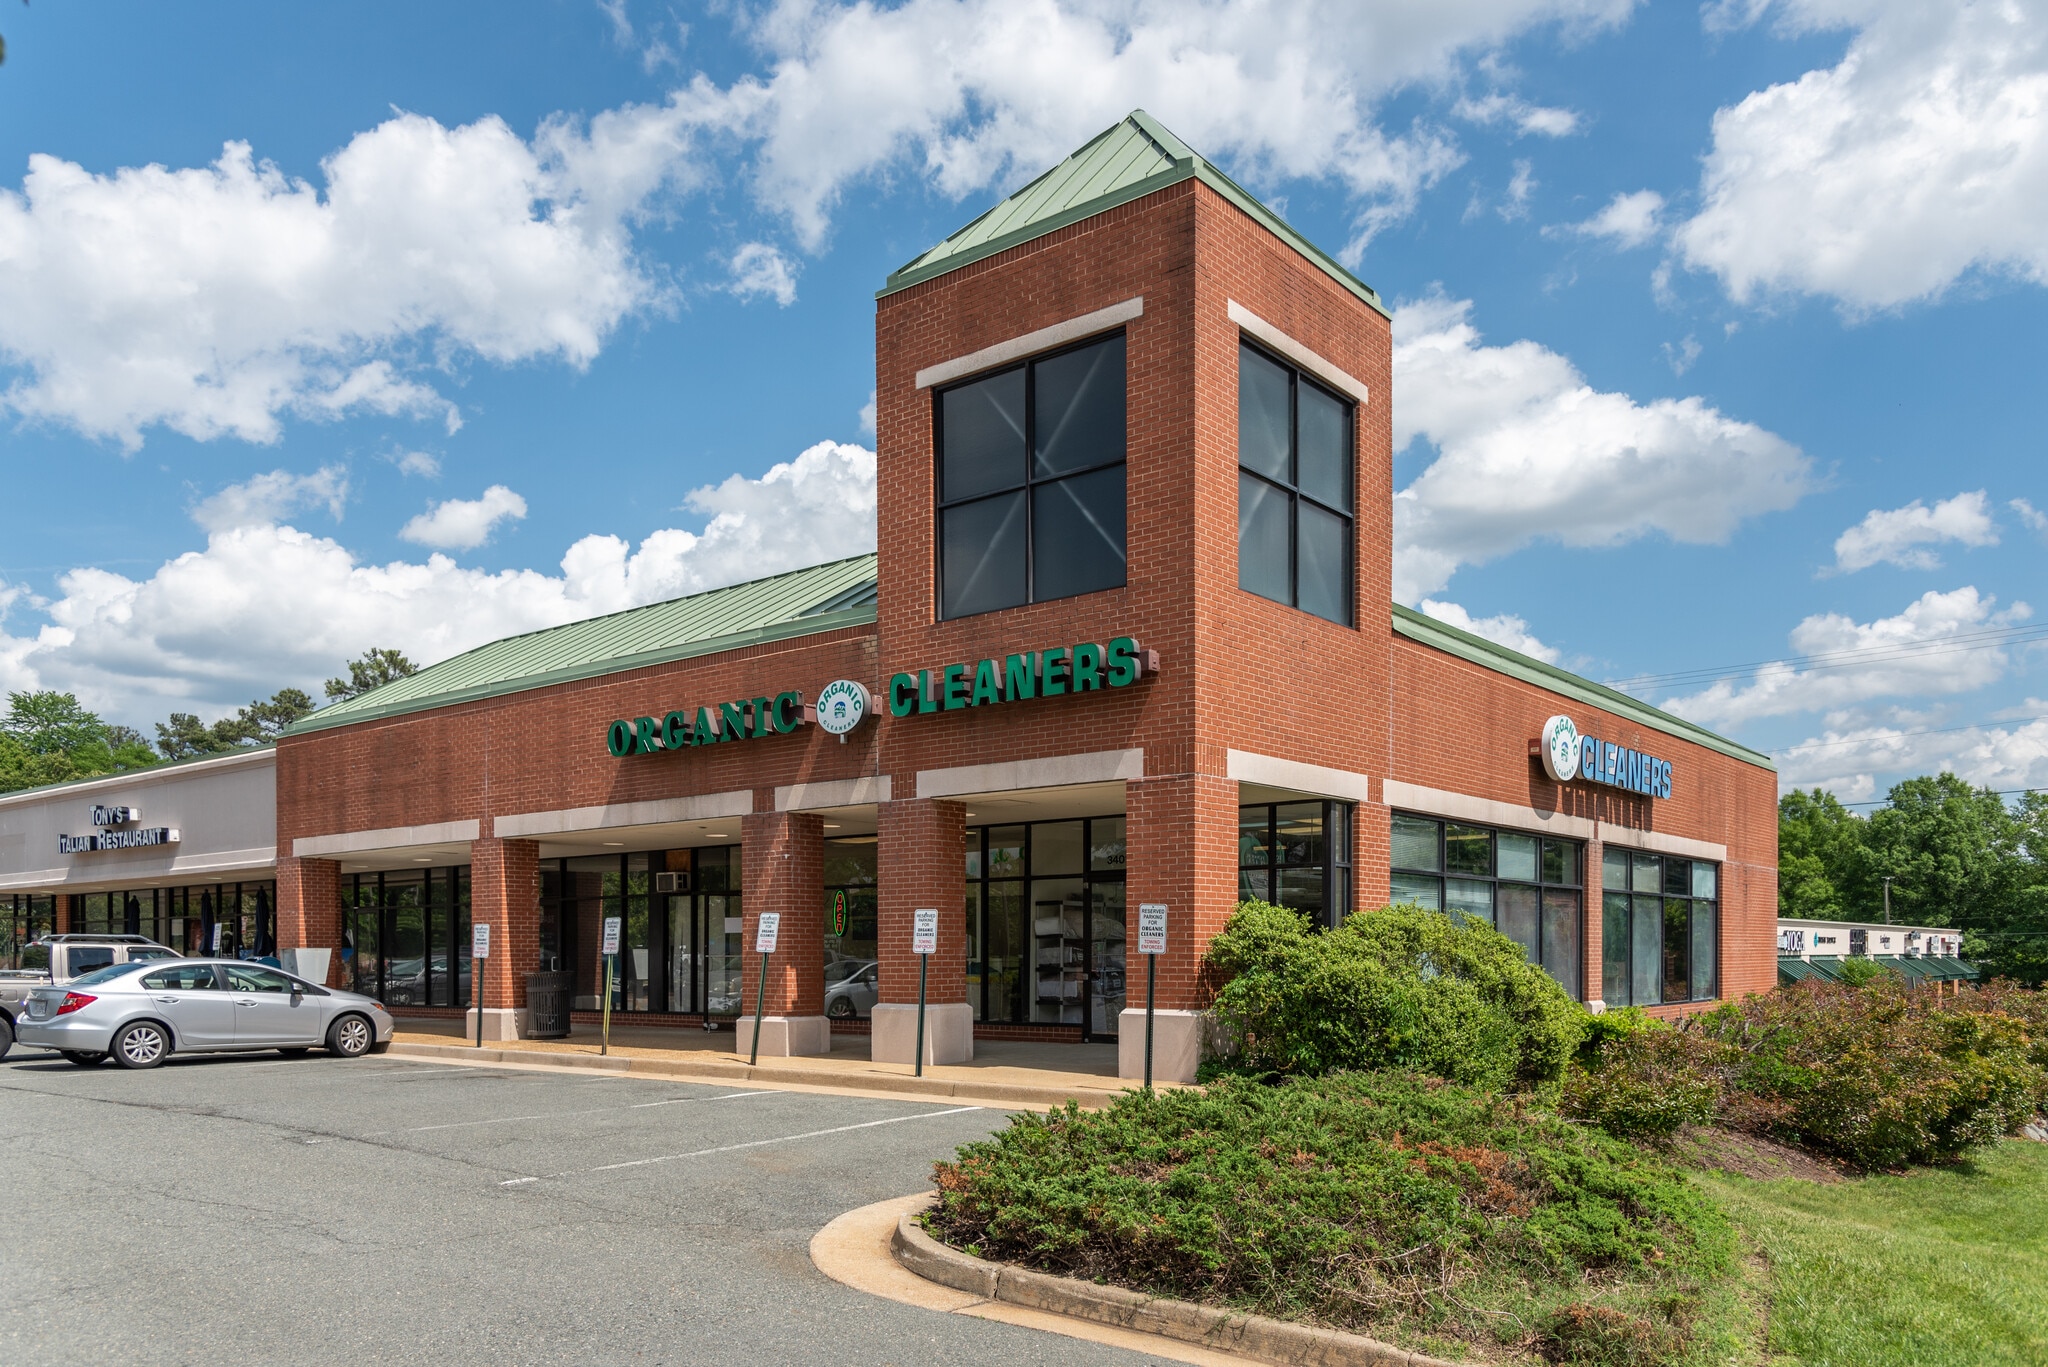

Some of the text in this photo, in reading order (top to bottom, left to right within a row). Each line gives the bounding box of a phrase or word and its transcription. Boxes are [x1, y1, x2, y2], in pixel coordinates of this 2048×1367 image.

[607, 637, 1142, 758] ORGANIC CLEANERS
[819, 681, 861, 713] ORGANIC
[823, 717, 855, 731] CLEANERS
[1551, 718, 1579, 757] ORGANIC
[1581, 735, 1672, 800] CLEANERS
[89, 804, 124, 826] TONY'S
[57, 827, 162, 854] ITALIAN RESTAURANT
[1107, 855, 1125, 865] 340
[1786, 931, 1805, 951] YOGA
